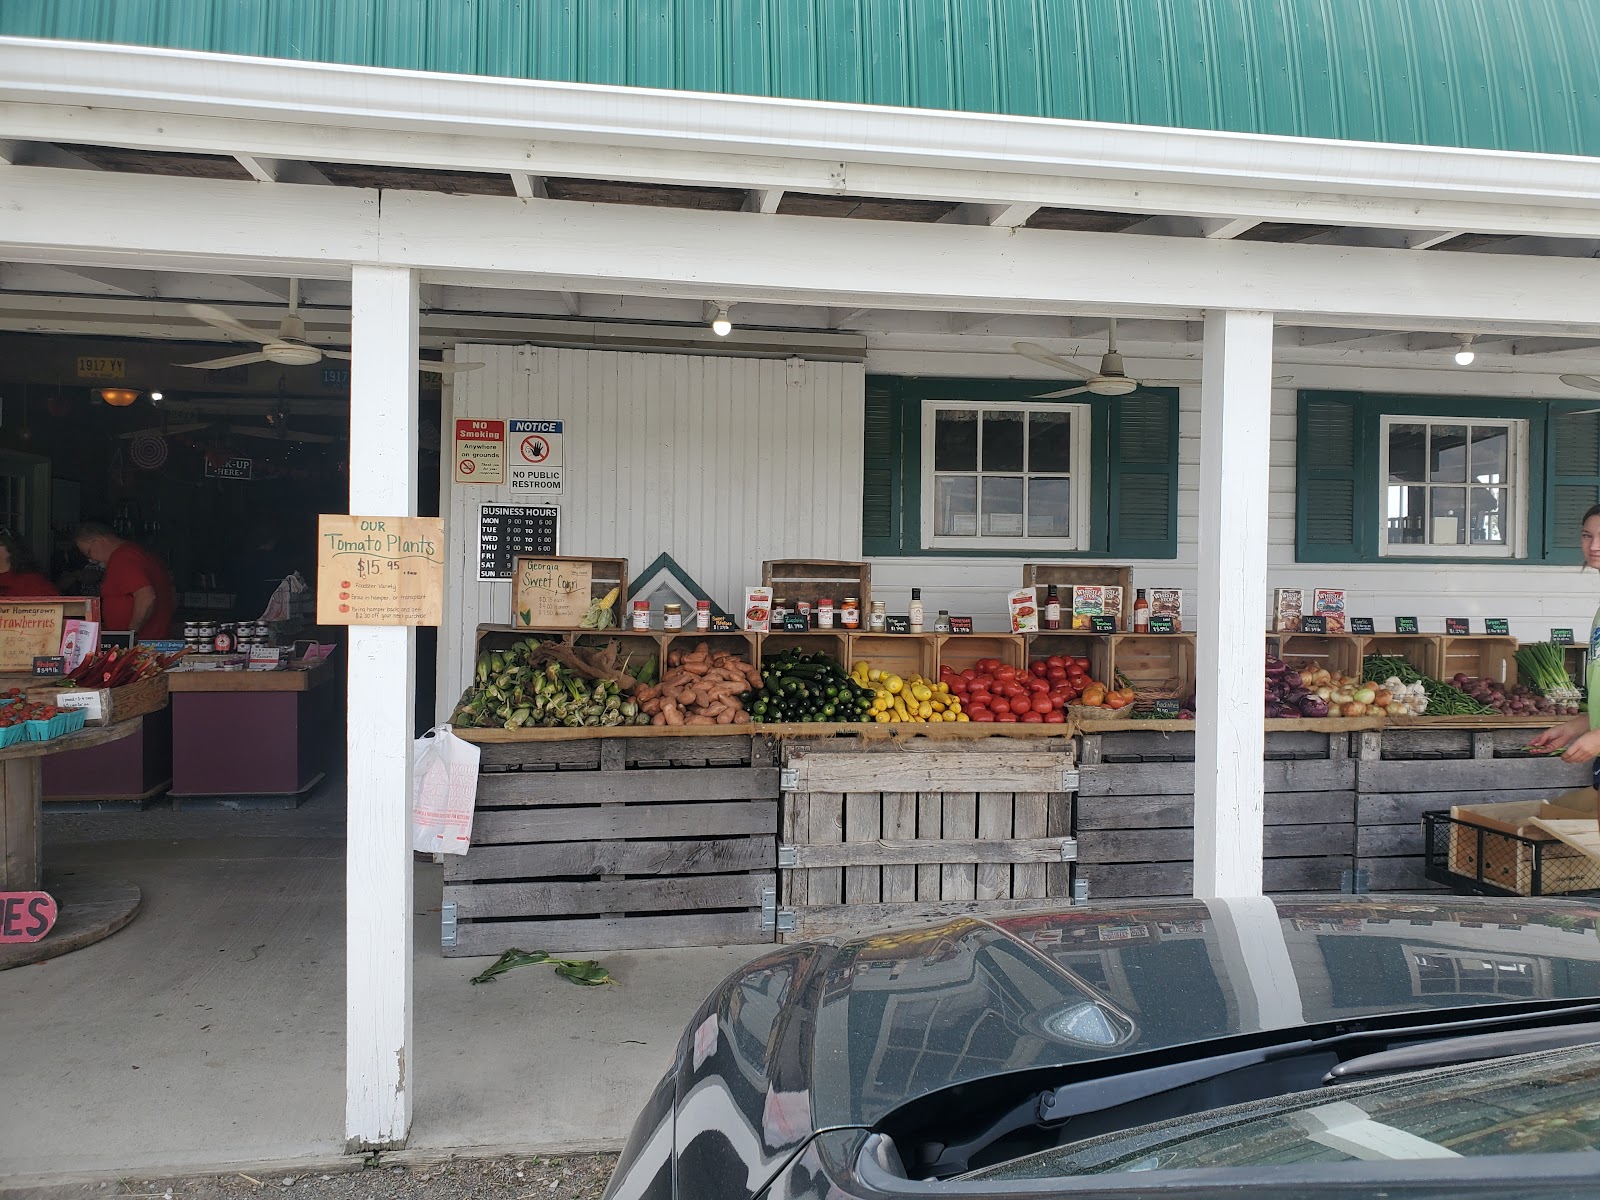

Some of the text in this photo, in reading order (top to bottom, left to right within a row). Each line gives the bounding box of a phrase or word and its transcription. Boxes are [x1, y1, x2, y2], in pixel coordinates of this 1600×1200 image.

[80, 360, 105, 371] 1917
[516, 422, 556, 432] NOTICE
[460, 430, 500, 439] Smoking
[482, 507, 524, 516] BUSINESS
[360, 520, 386, 532] OUR
[324, 533, 435, 555] Tomato Plants
[528, 560, 559, 574] Georgia
[523, 572, 578, 589] Sweet Corn
[13, 607, 55, 616] Homegrown
